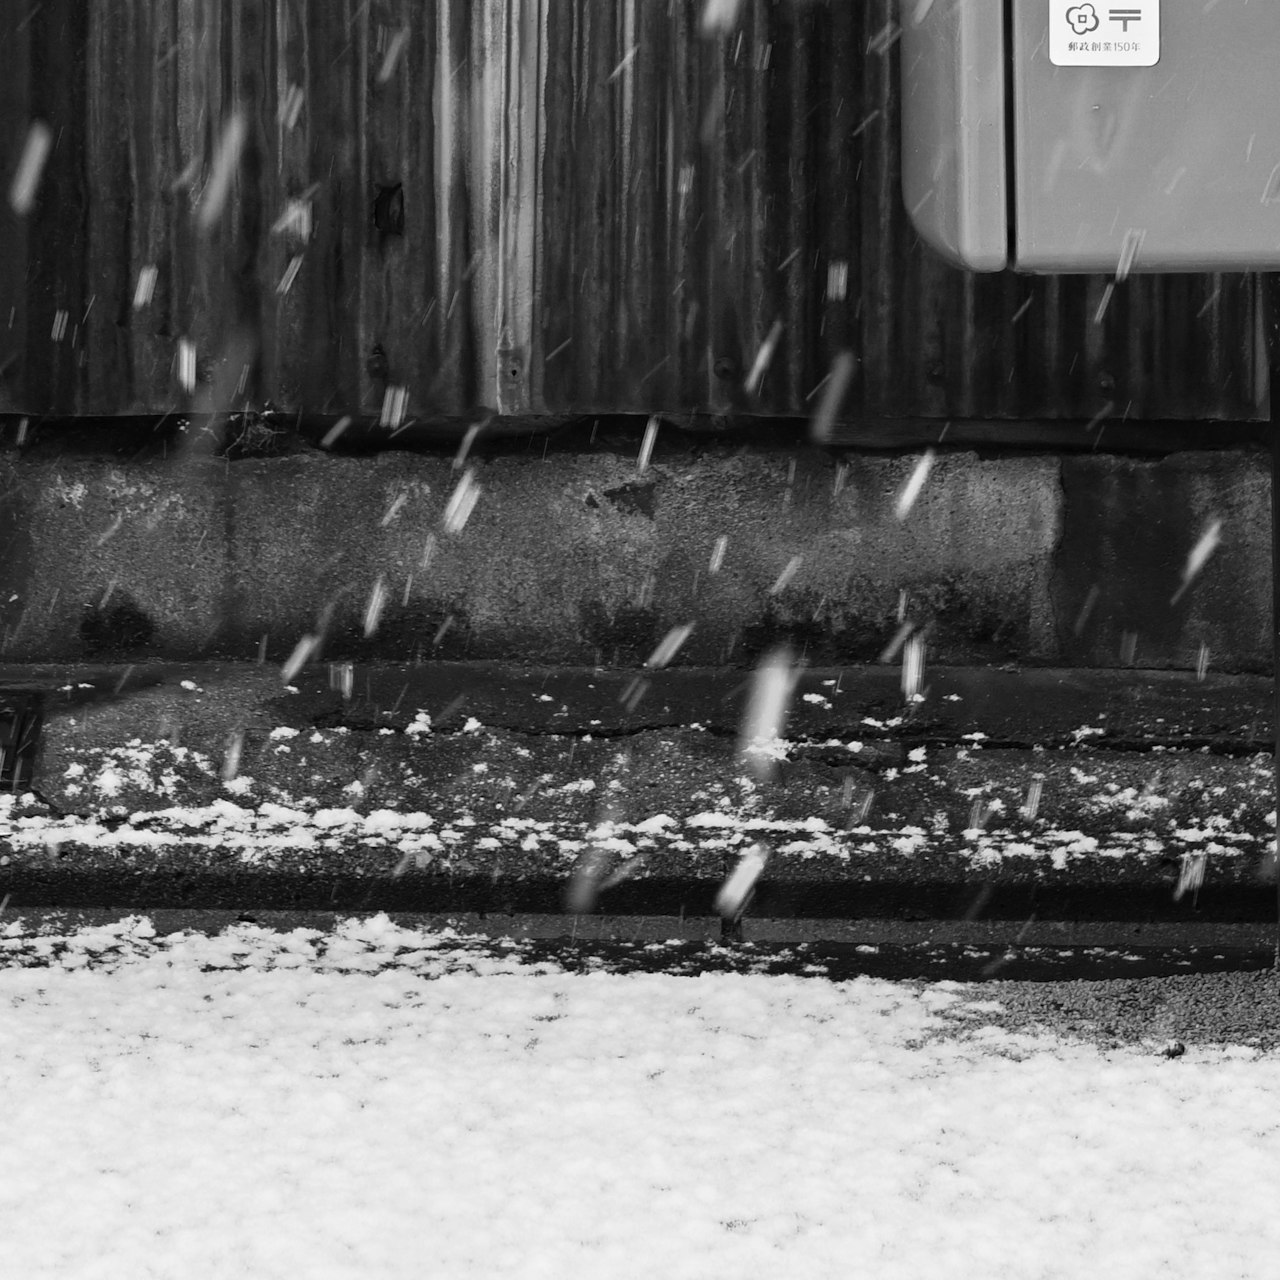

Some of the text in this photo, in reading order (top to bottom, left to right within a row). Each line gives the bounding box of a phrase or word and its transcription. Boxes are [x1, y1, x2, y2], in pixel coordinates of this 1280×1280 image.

[1068, 41, 1141, 52] 郵政創業150年
